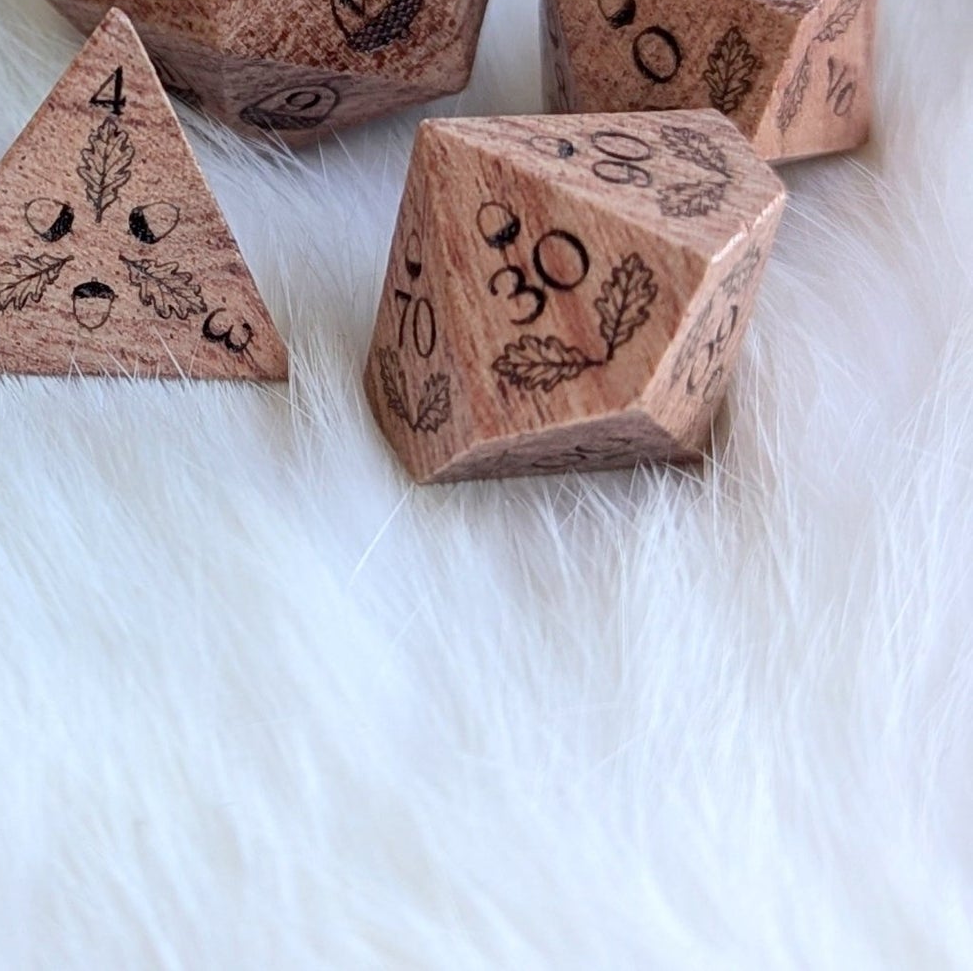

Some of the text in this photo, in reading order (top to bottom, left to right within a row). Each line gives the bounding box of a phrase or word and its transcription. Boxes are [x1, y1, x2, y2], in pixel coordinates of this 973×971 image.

[632, 26, 683, 84] 0
[89, 65, 127, 115] 4
[590, 130, 652, 188] 90
[487, 229, 591, 325] 30
[202, 307, 253, 353] 3
[394, 288, 437, 359] 70
